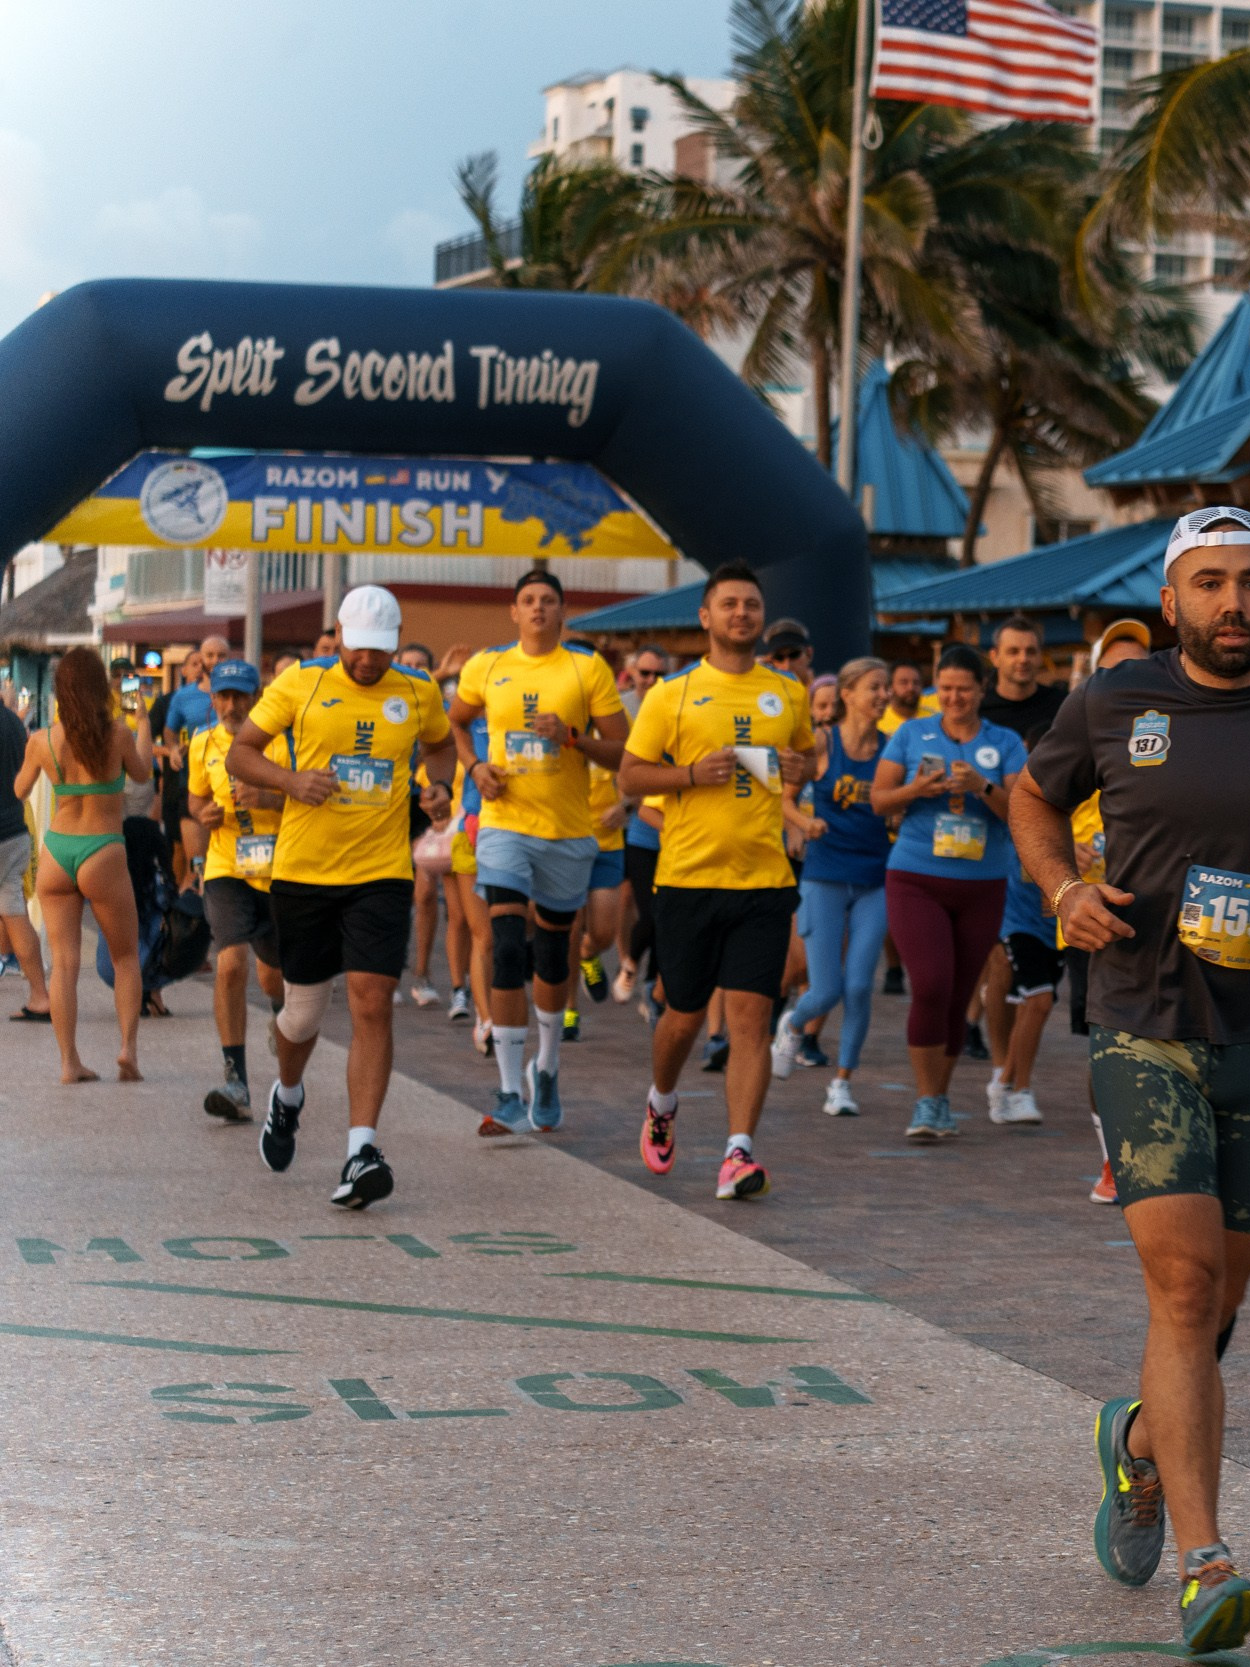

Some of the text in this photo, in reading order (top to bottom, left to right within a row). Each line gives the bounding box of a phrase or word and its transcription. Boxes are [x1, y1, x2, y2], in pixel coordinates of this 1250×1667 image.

[164, 330, 599, 428] Split Second Timing
[266, 465, 471, 491] RAZOM RUN
[252, 496, 484, 547] FINISH
[522, 740, 544, 761] 48
[348, 768, 375, 792] 50
[1199, 872, 1243, 889] RAZOM
[150, 1366, 873, 1425] SLOW
